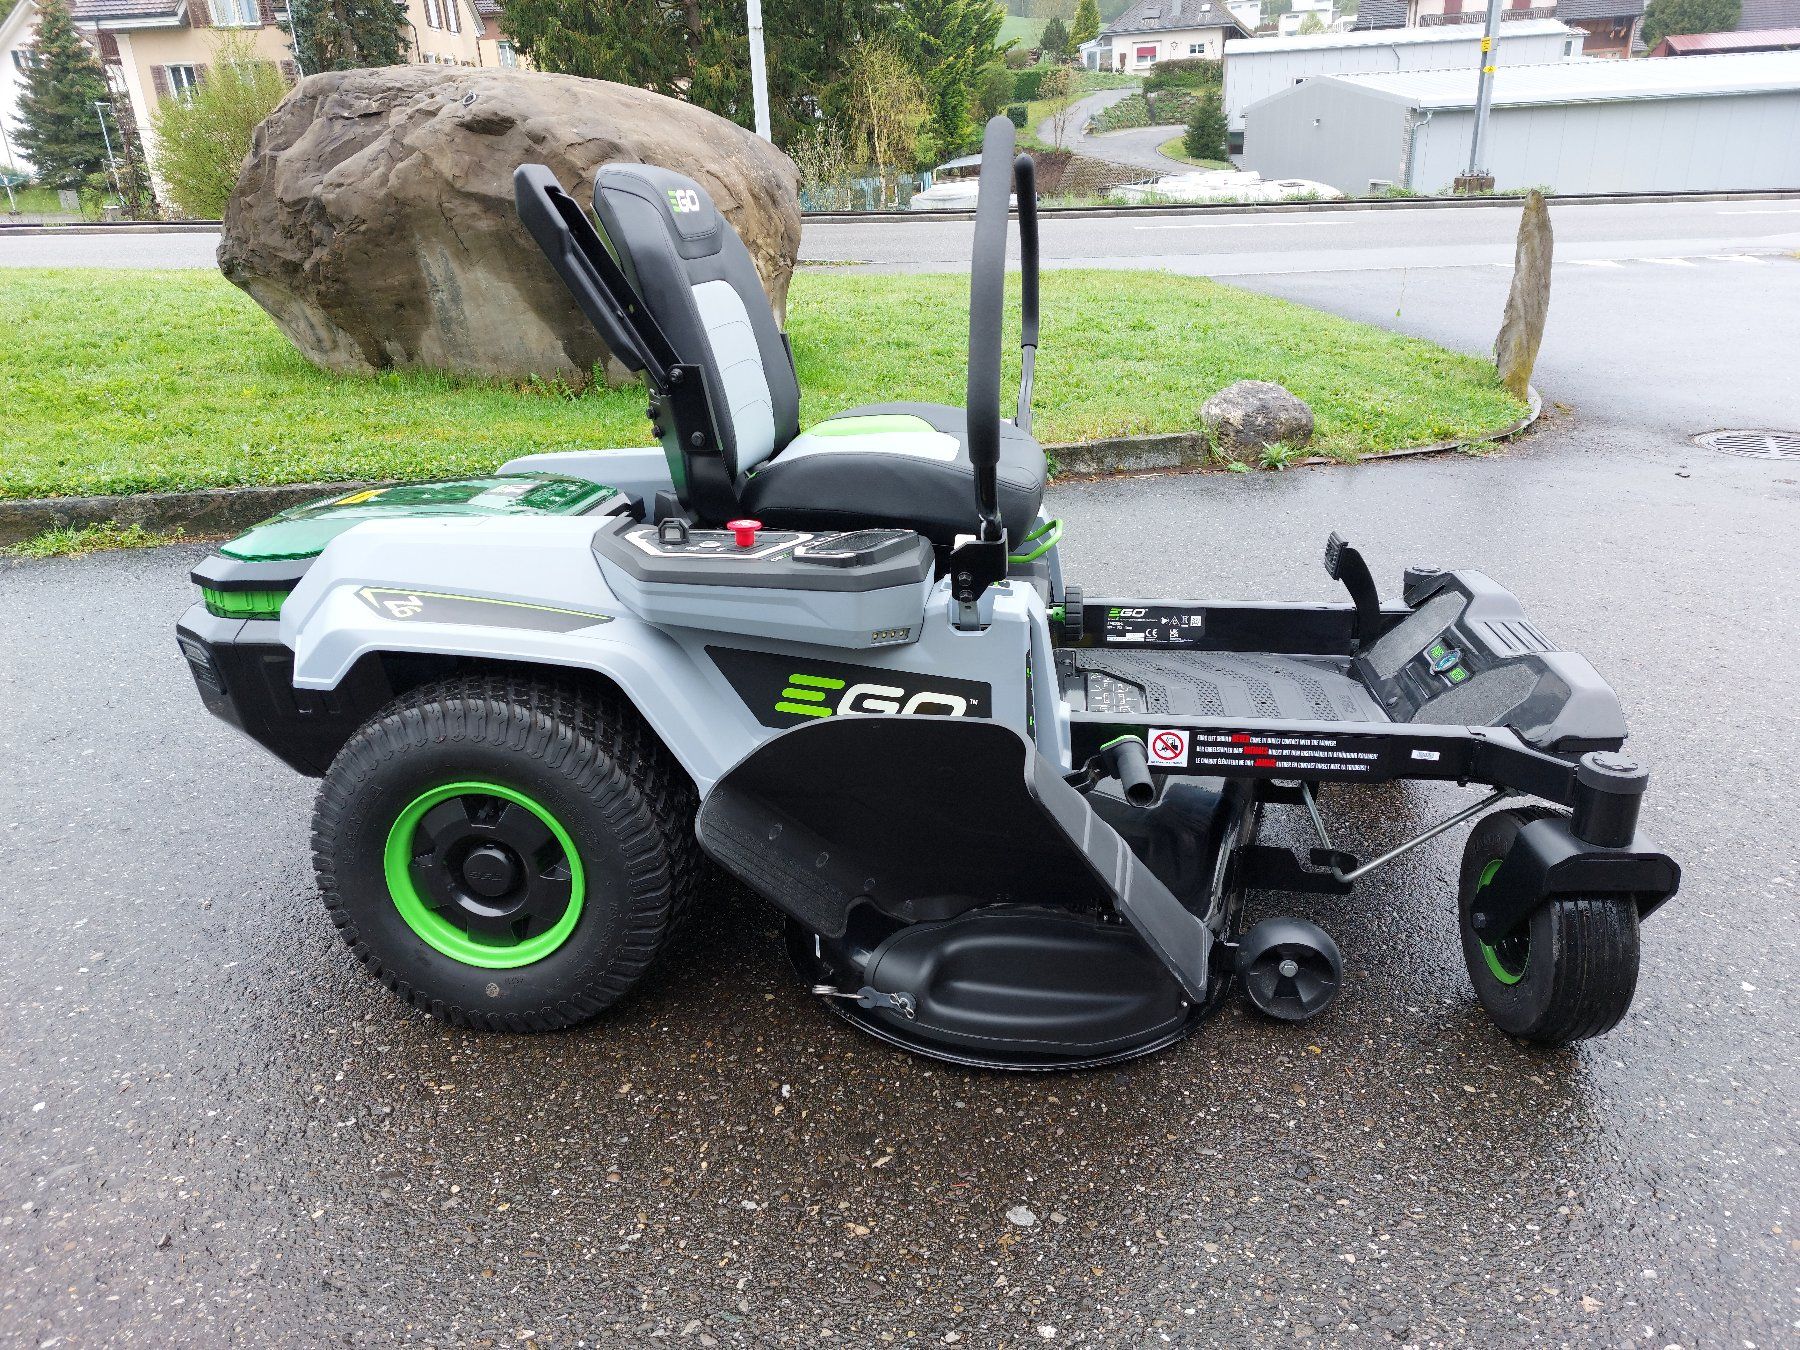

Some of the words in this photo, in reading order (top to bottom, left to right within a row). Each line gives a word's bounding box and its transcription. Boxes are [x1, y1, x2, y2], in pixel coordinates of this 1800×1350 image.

[667, 189, 700, 213] EGO
[1108, 608, 1146, 617] EGO
[774, 673, 967, 718] EGO
